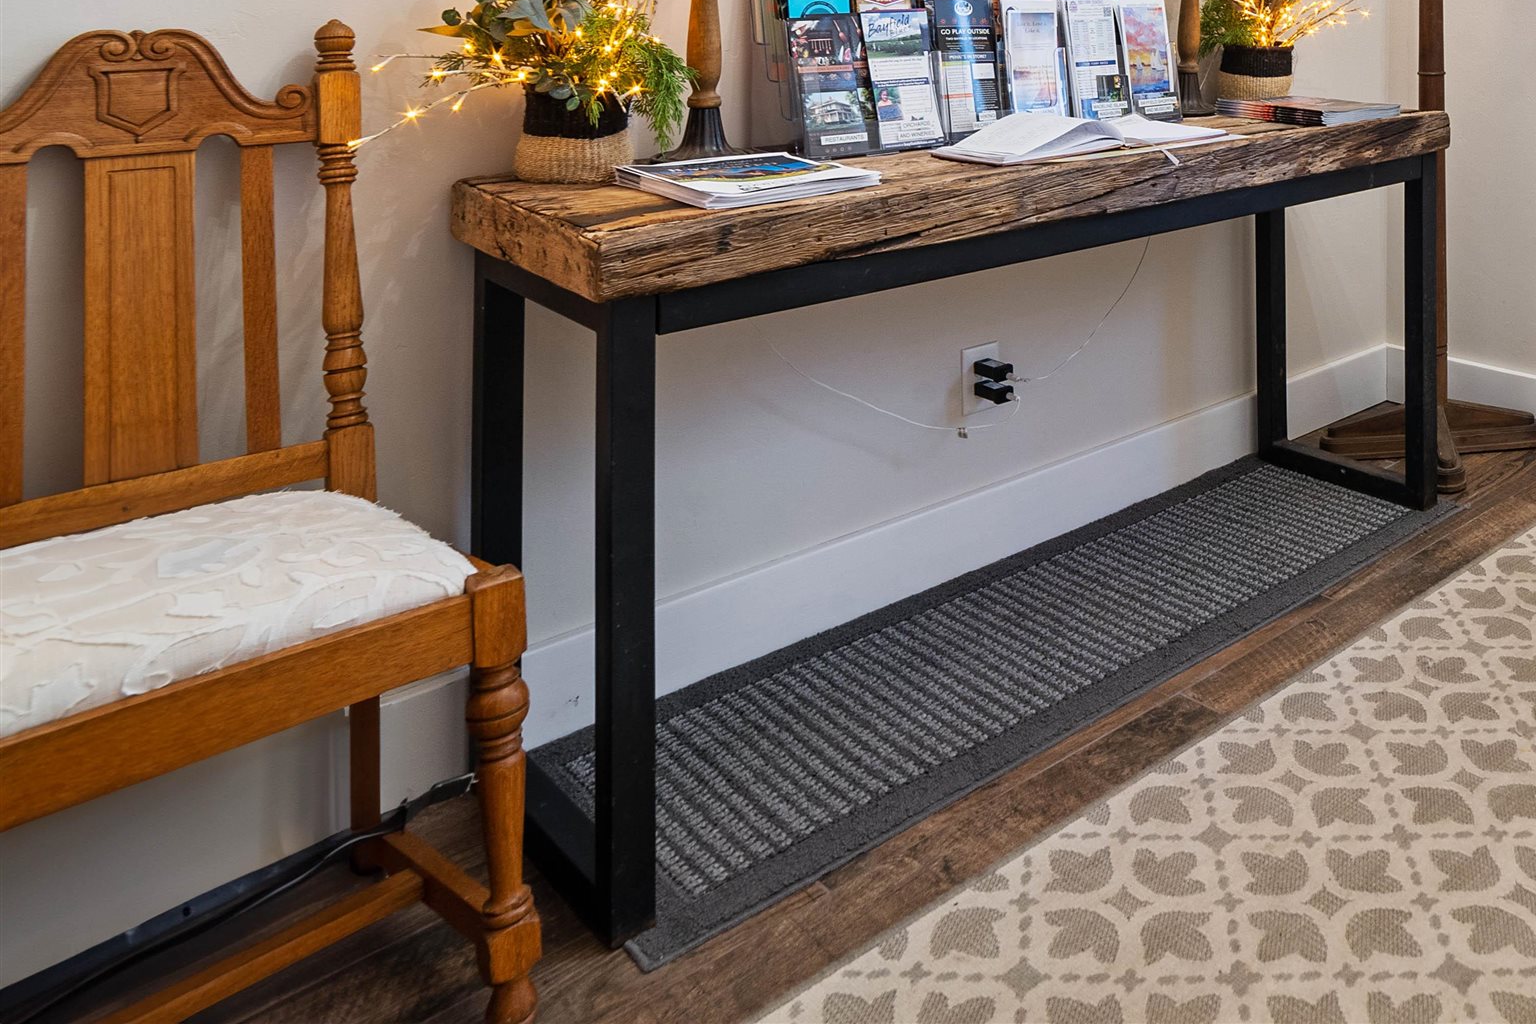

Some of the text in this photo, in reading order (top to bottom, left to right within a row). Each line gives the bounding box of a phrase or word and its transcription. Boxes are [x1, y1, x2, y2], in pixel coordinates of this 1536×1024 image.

[868, 13, 910, 38] Bayfield
[902, 120, 931, 129] ORCHARDS
[824, 134, 865, 143] RESTAURANTS
[911, 130, 935, 138] WINERIES
